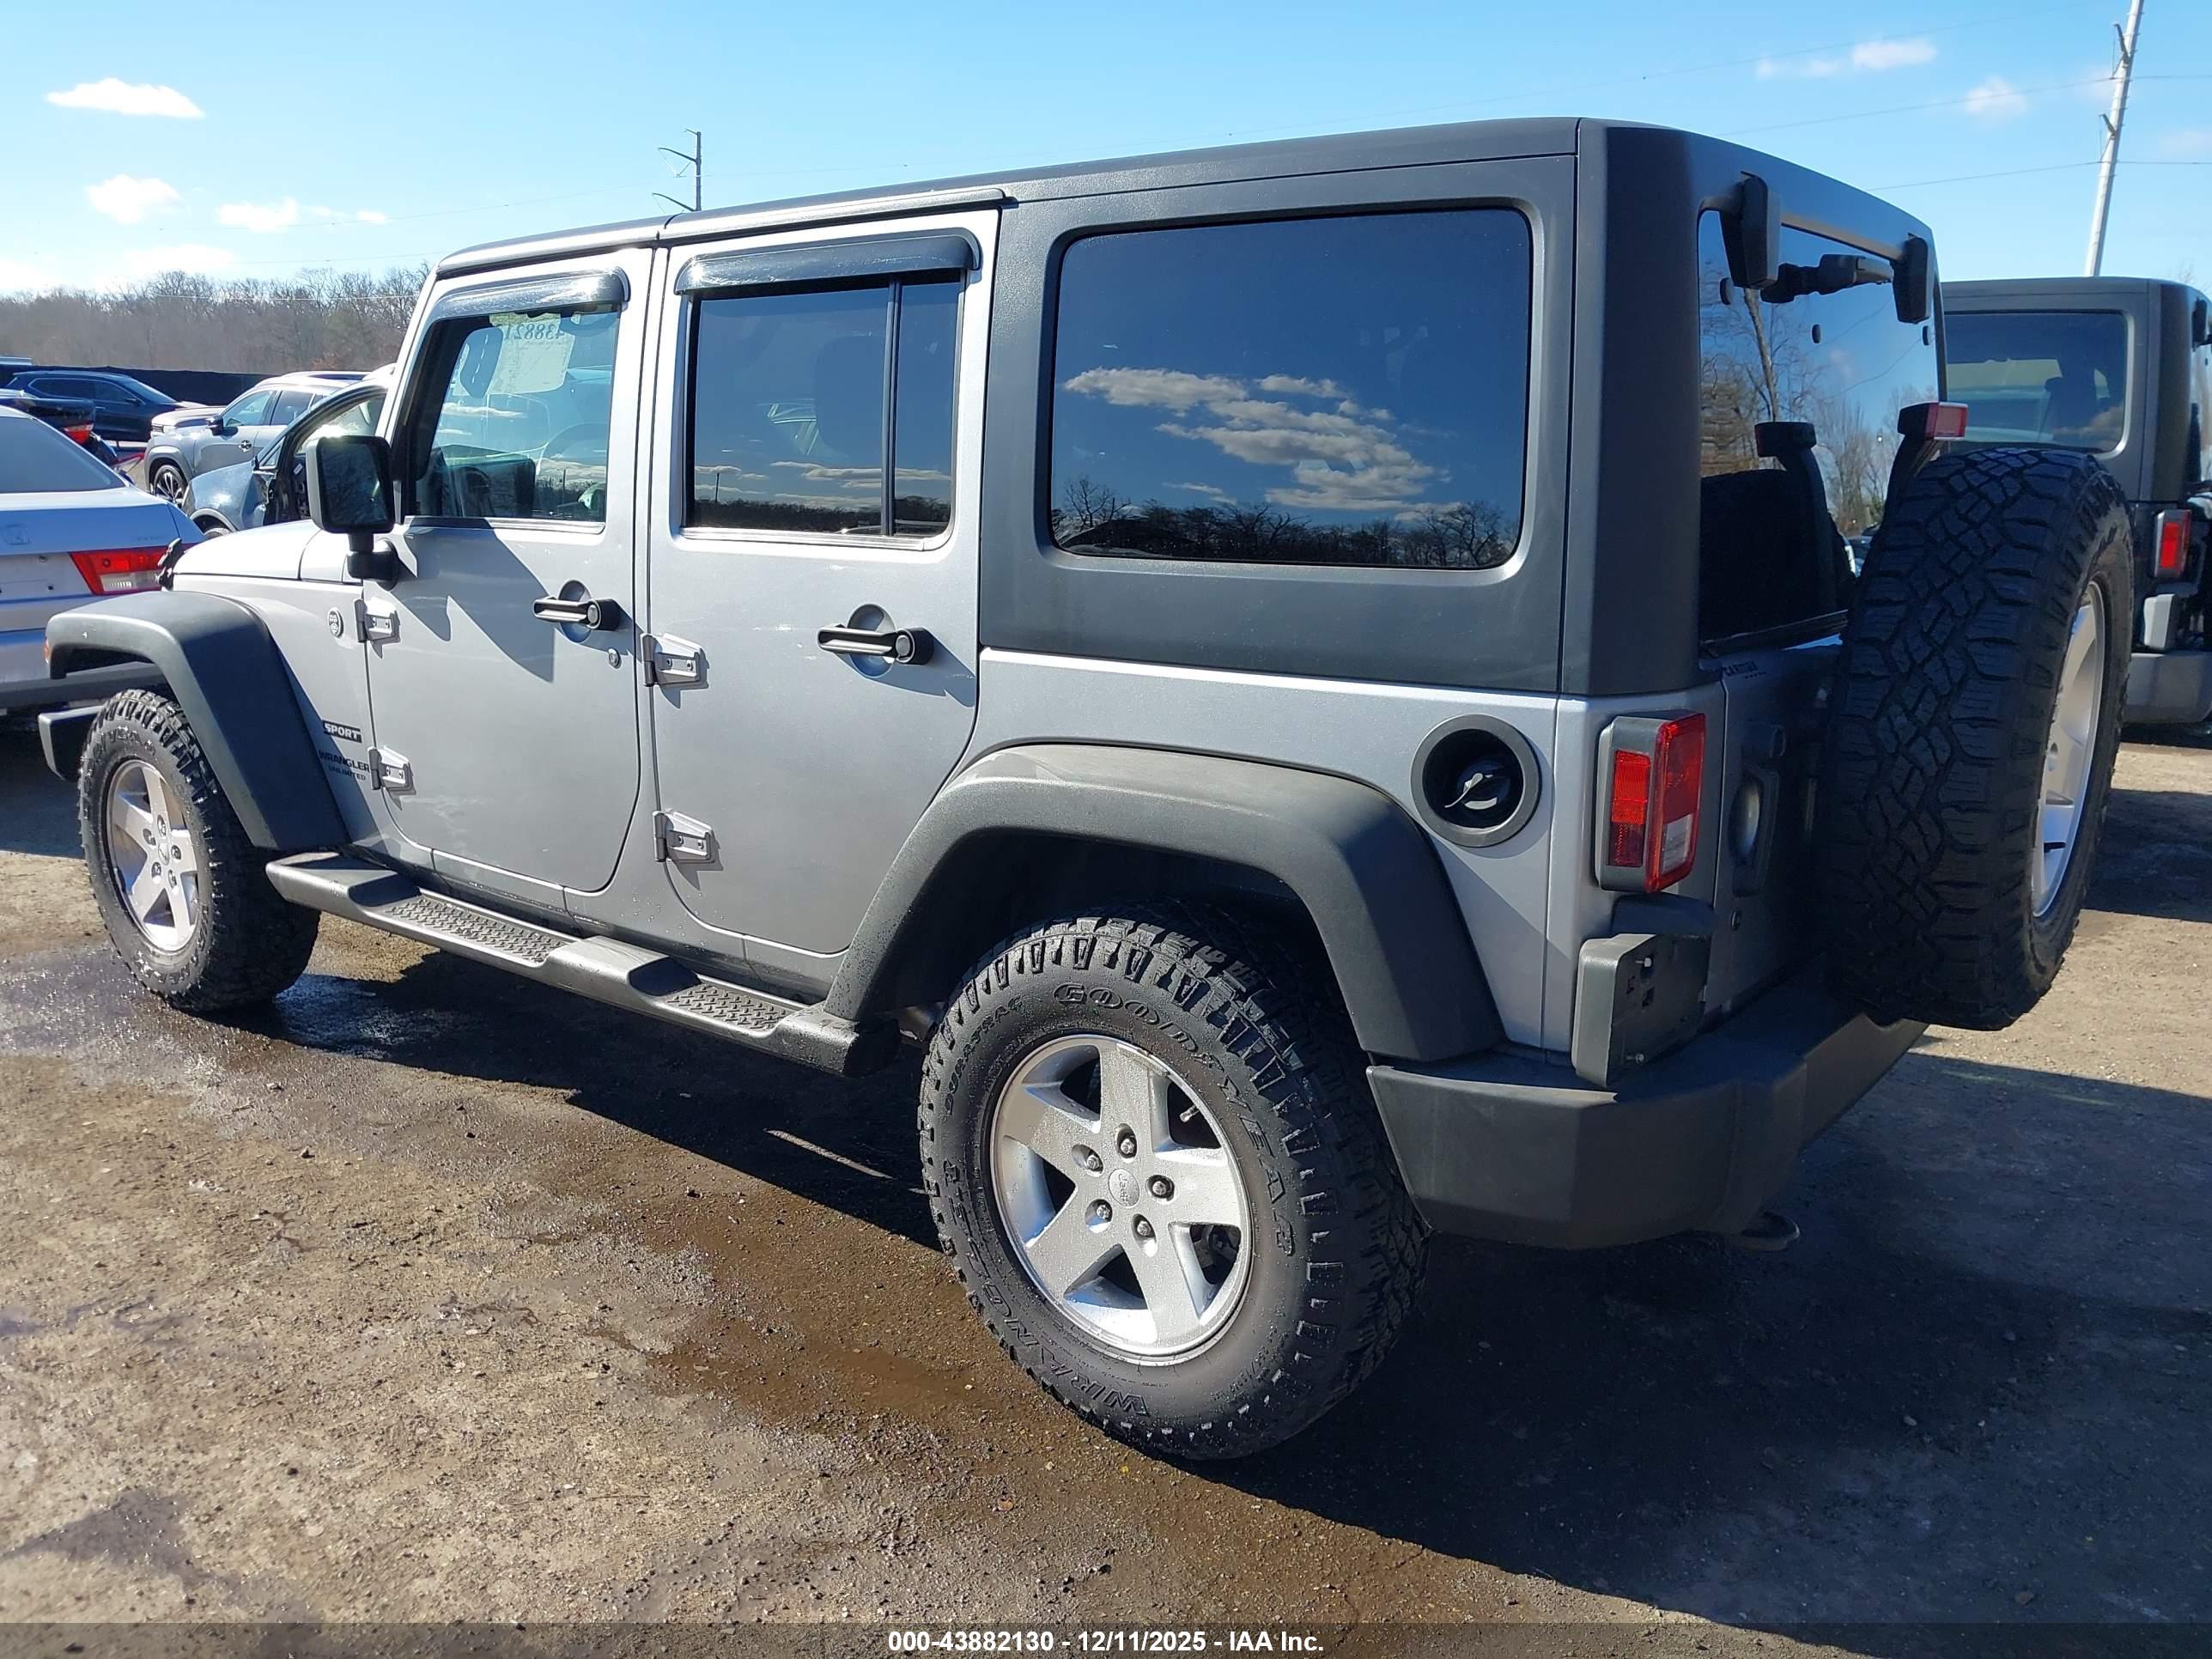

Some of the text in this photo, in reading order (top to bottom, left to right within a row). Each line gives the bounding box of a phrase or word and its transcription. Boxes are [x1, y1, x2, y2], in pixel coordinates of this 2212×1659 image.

[324, 722, 362, 740] SPORT
[319, 750, 370, 773] WRANGLER
[328, 765, 367, 781] UNLIMITED
[1053, 981, 1296, 1257] GOODYEAR
[942, 1157, 1151, 1419] WRANGLER
